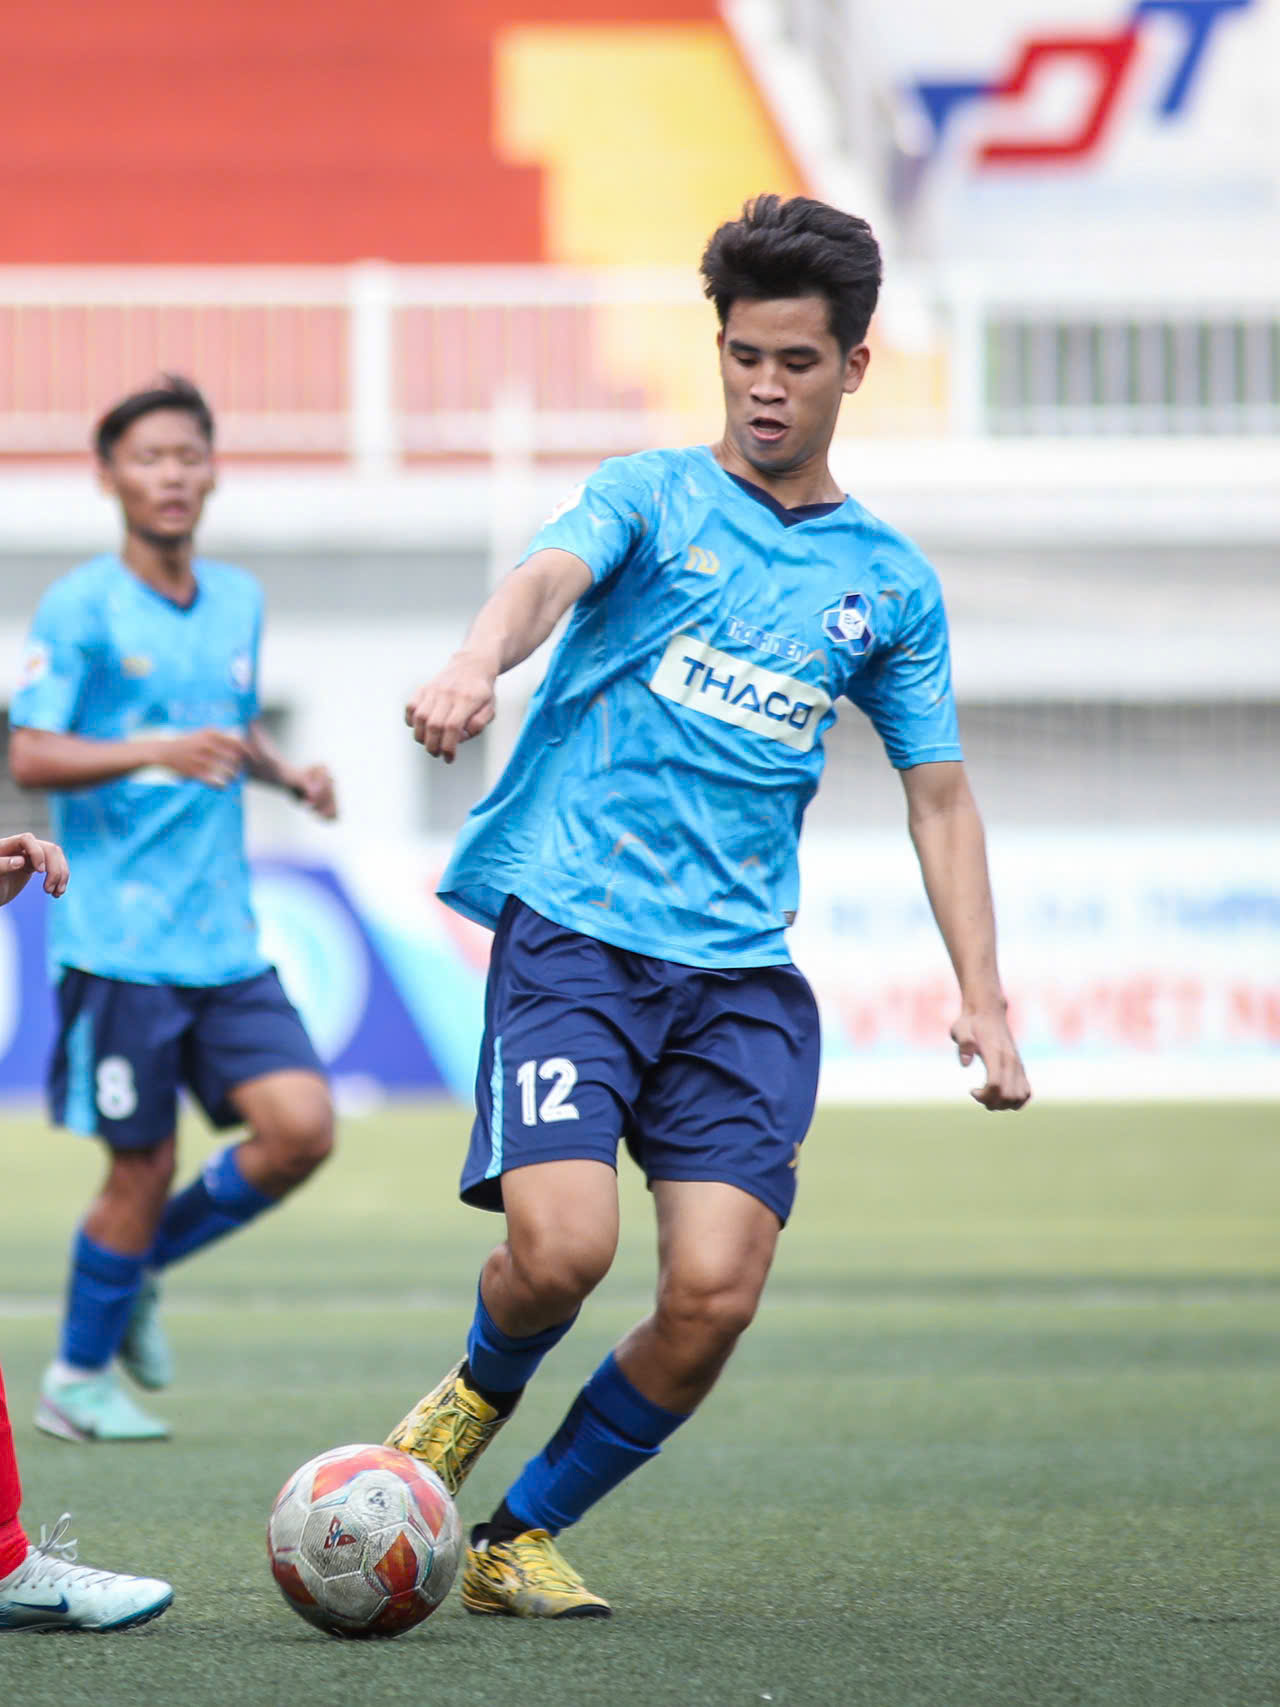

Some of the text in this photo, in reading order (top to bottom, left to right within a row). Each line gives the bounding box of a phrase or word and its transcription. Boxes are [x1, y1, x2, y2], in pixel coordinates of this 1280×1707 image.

[682, 656, 814, 730] THACO
[96, 1056, 138, 1120] 8
[516, 1057, 580, 1127] 12
